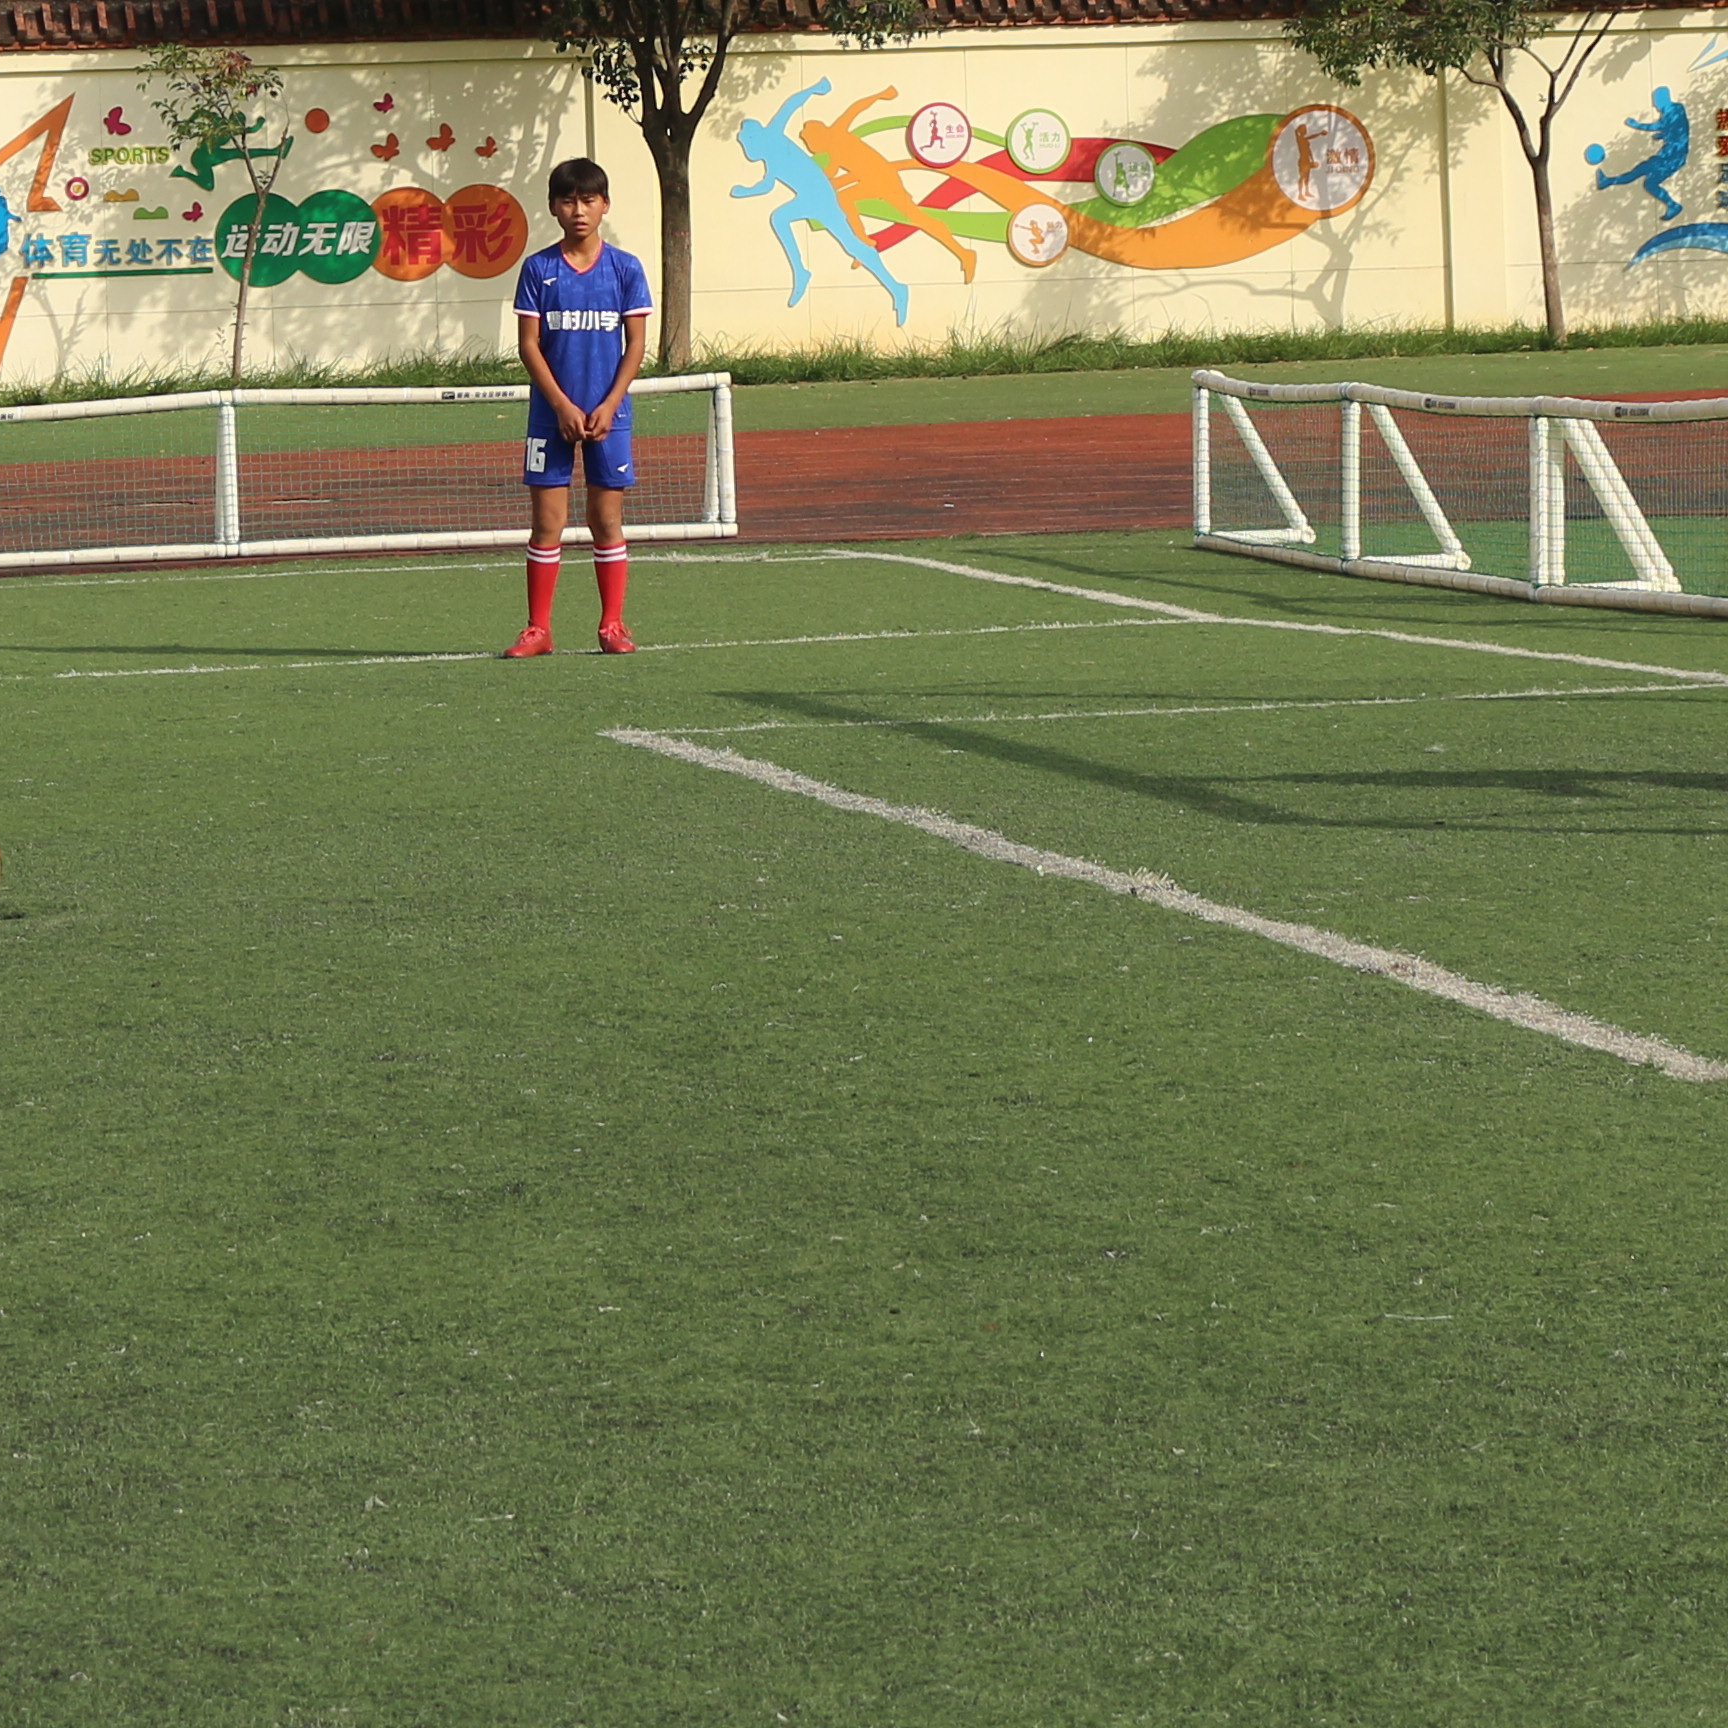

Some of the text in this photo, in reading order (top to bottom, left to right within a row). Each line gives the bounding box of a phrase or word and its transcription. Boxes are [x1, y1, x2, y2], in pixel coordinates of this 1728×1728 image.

[1039, 132, 1060, 142] 活力
[89, 146, 170, 165] SPORTS
[20, 203, 514, 268] 体育无处不在 运动无限 精彩
[546, 310, 620, 332] 曹村小学
[526, 436, 548, 473] 16
